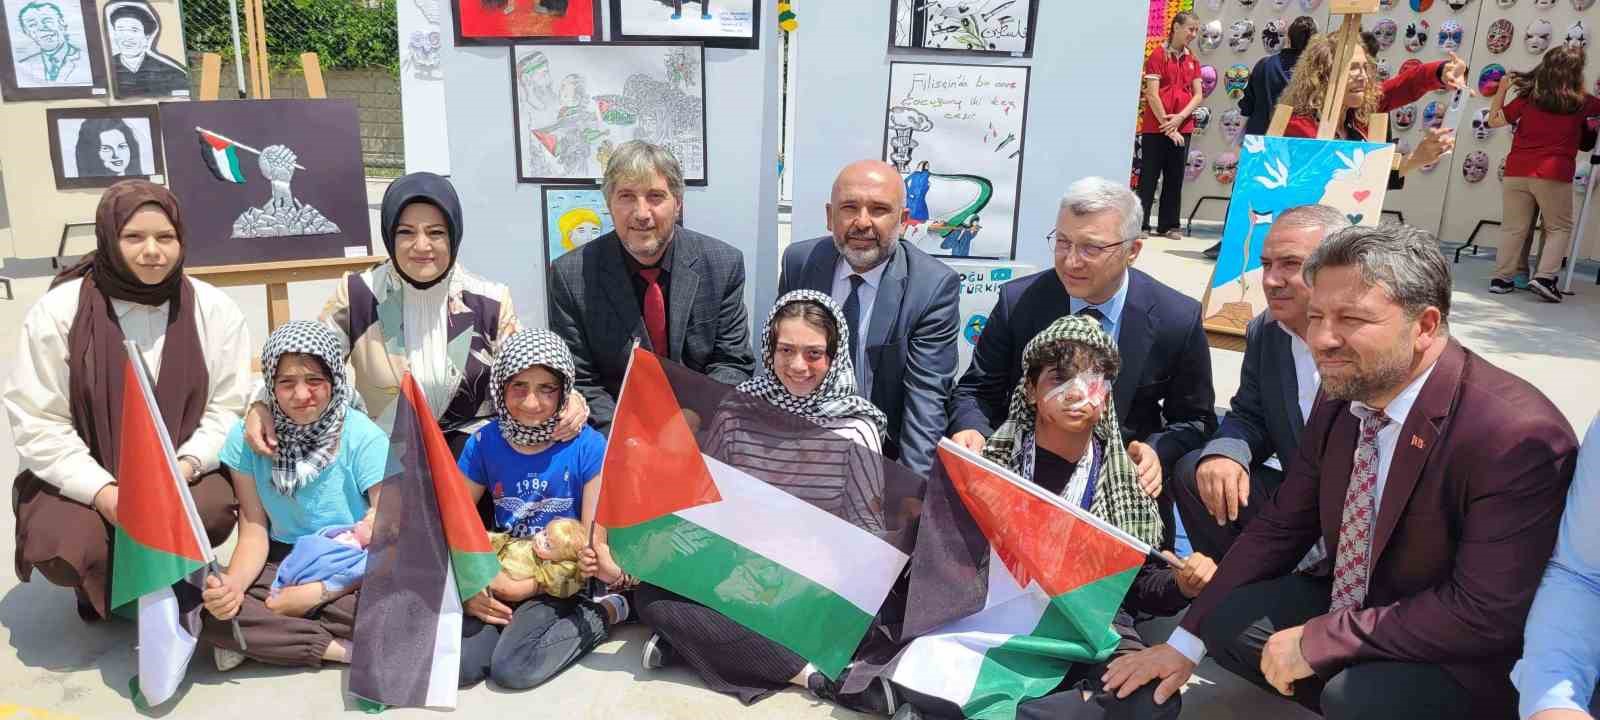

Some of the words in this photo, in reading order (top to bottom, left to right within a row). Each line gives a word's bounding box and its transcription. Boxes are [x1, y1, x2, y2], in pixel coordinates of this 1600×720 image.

[960, 272, 984, 282] OĞU
[960, 283, 1001, 294] TÜRKİ
[516, 478, 548, 493] 1989
